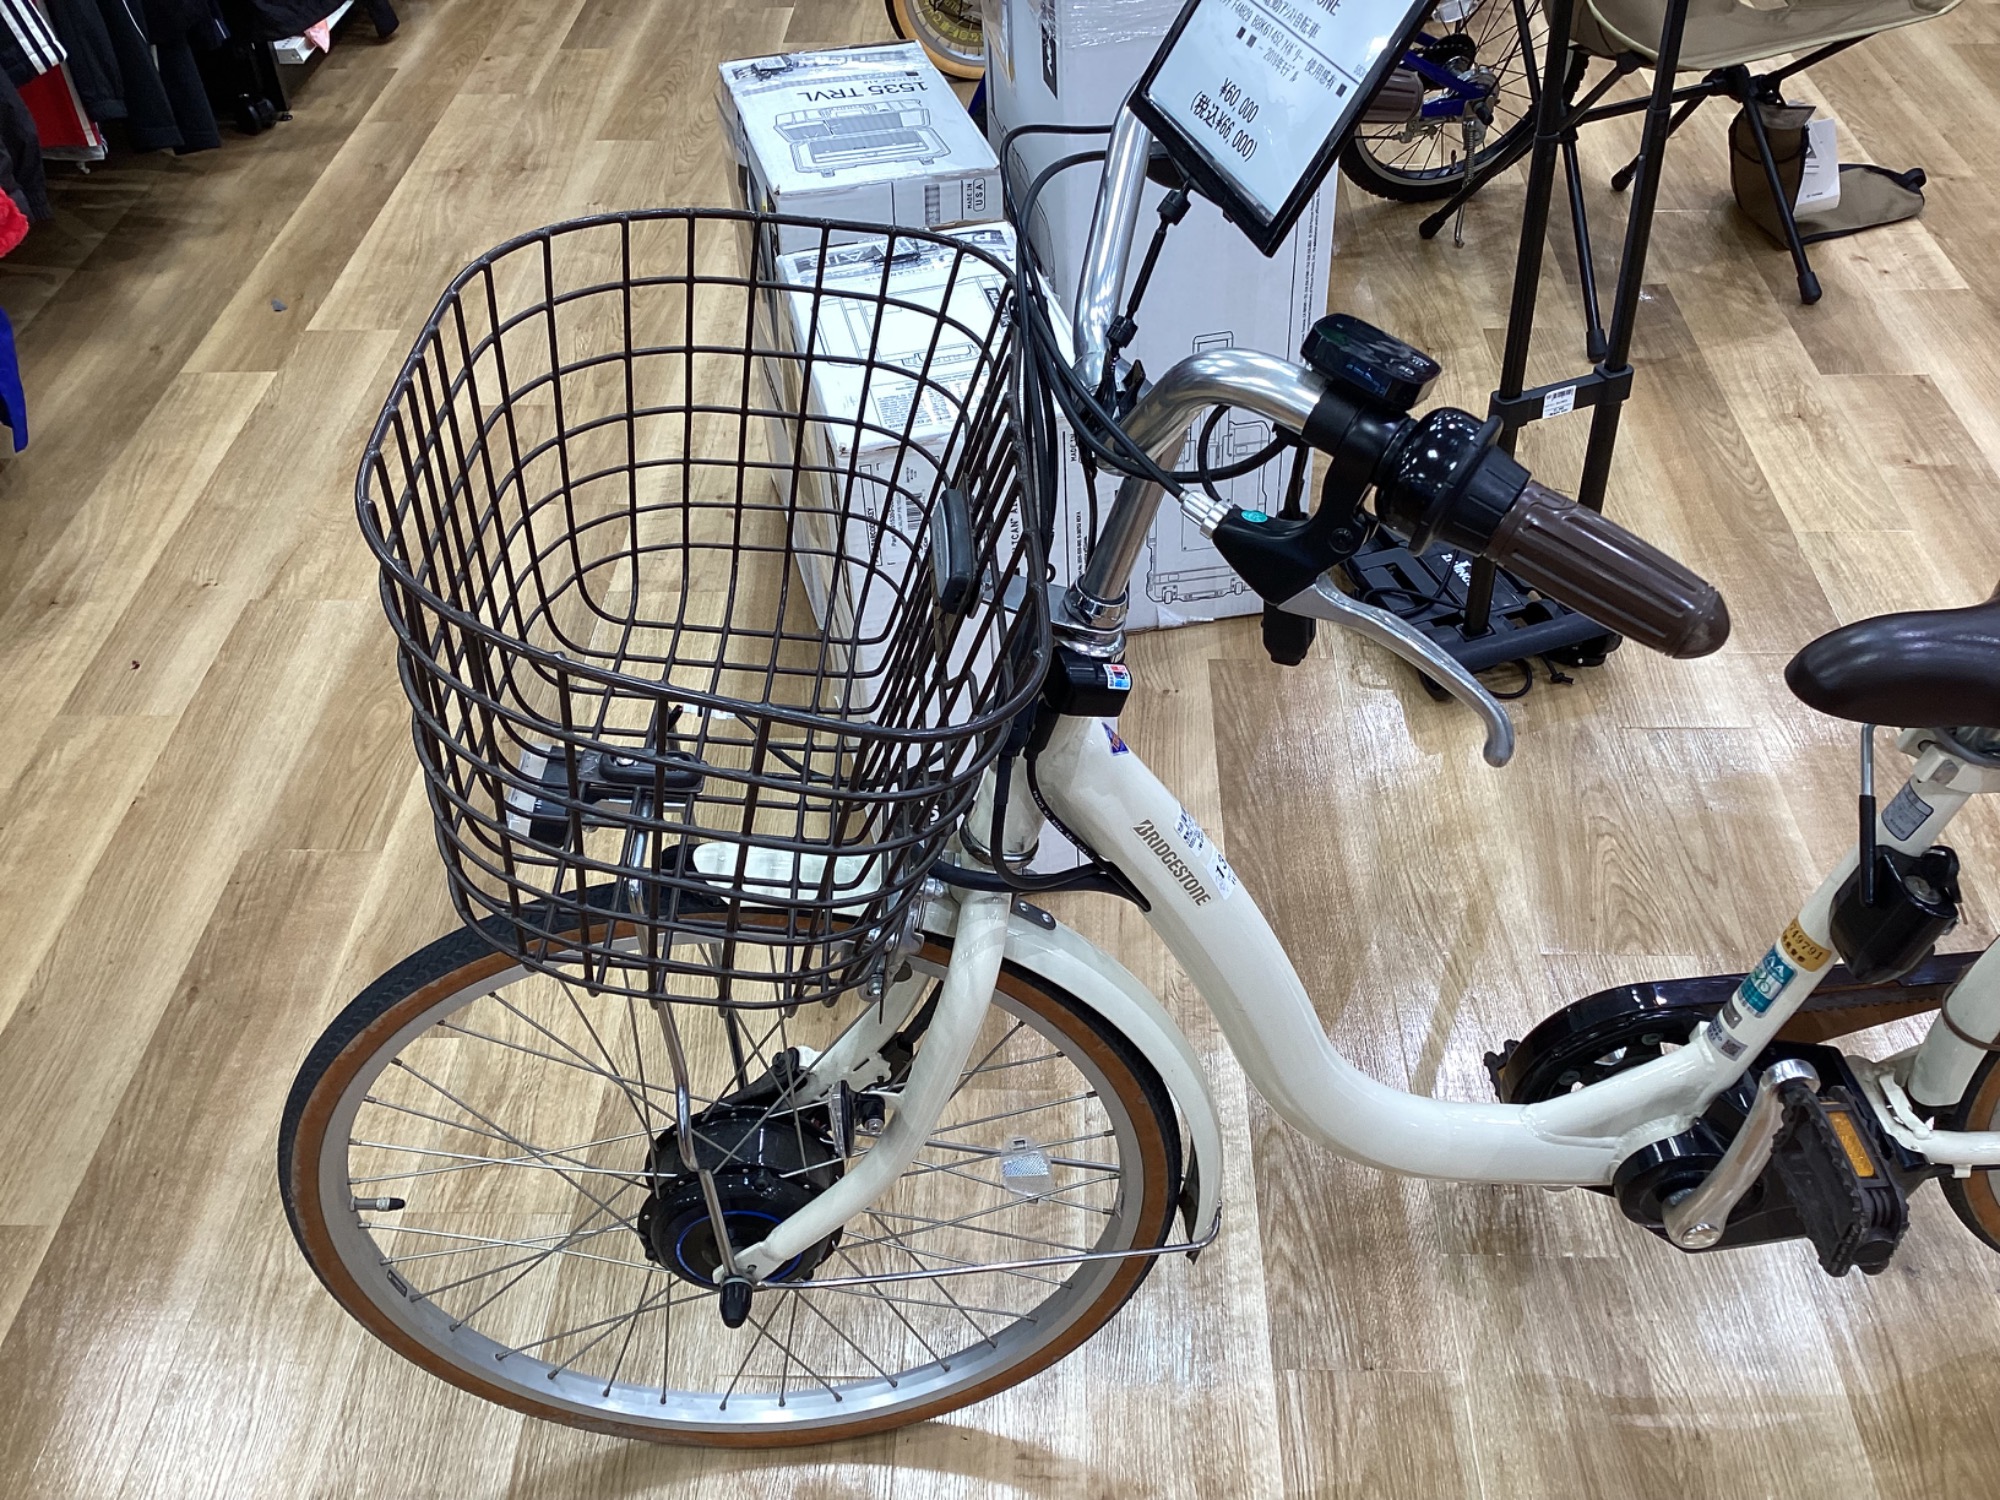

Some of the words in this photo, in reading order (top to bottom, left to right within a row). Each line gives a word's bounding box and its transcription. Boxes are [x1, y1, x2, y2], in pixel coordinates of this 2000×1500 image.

[797, 87, 864, 102] TRVL
[868, 81, 929, 97] 1535
[1218, 77, 1259, 124] ¥60,000
[975, 183, 984, 206] USA
[1133, 819, 1211, 906] BRIDGESTONE
